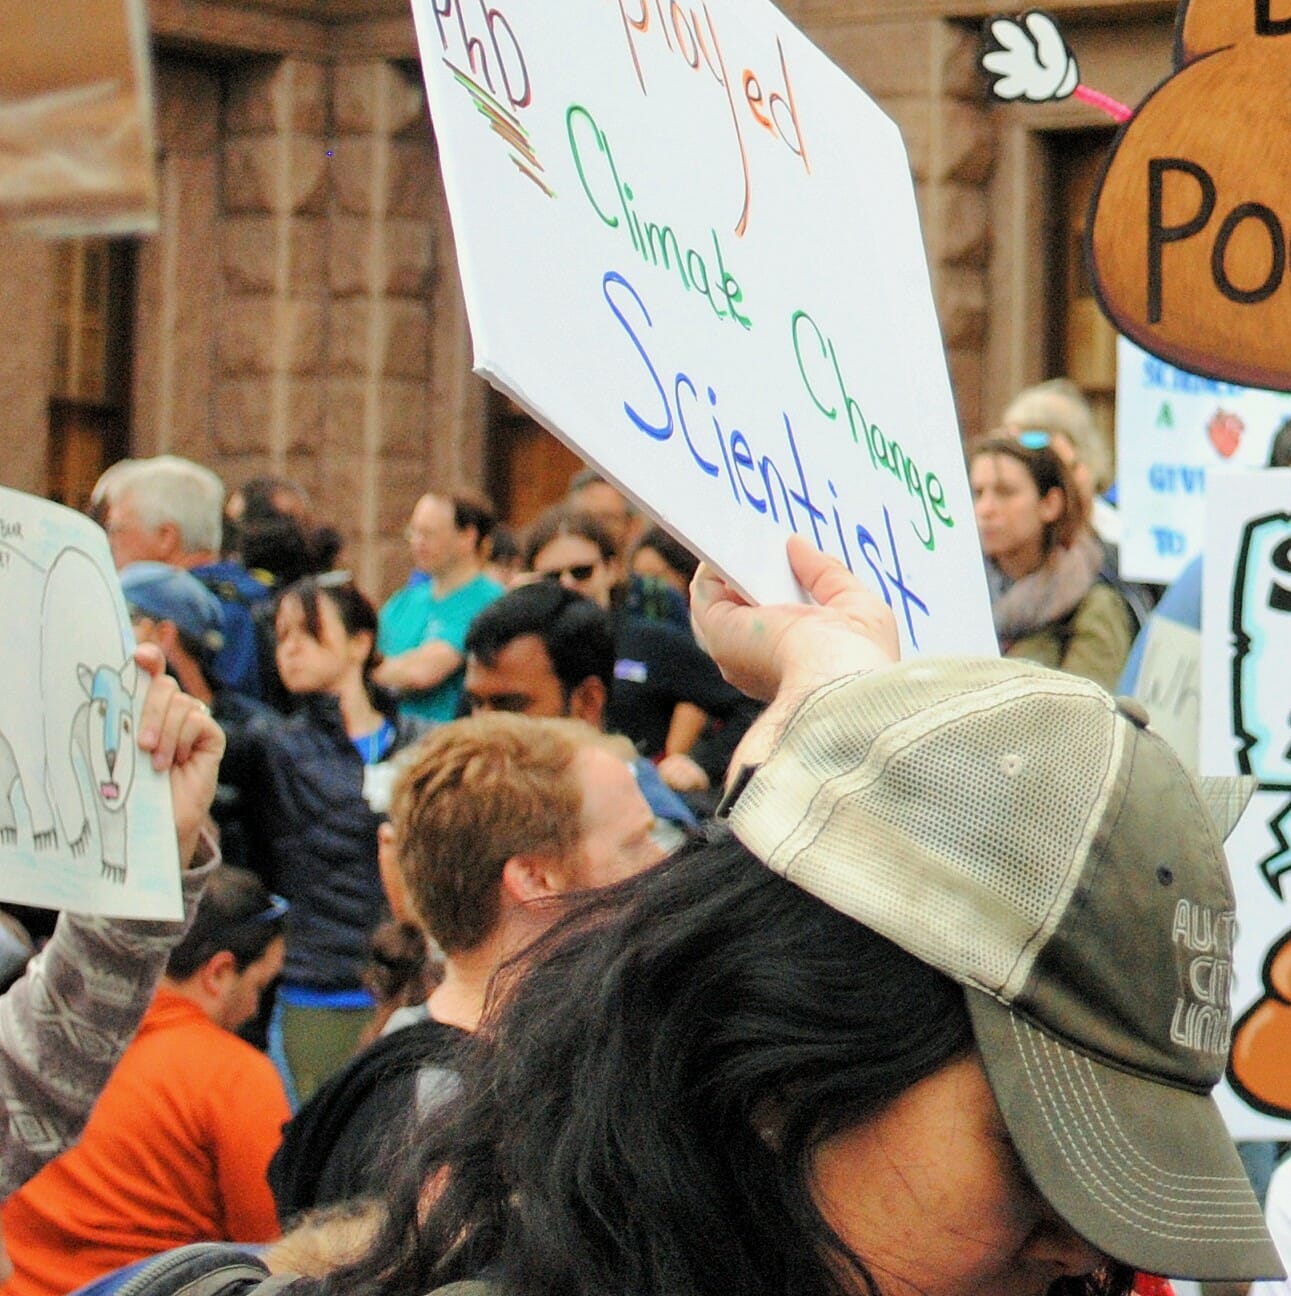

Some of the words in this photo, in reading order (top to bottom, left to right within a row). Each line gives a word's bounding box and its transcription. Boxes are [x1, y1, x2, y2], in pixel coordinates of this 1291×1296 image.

[566, 102, 753, 331] Climate
[791, 309, 955, 552] Change
[602, 270, 931, 652] Scientist
